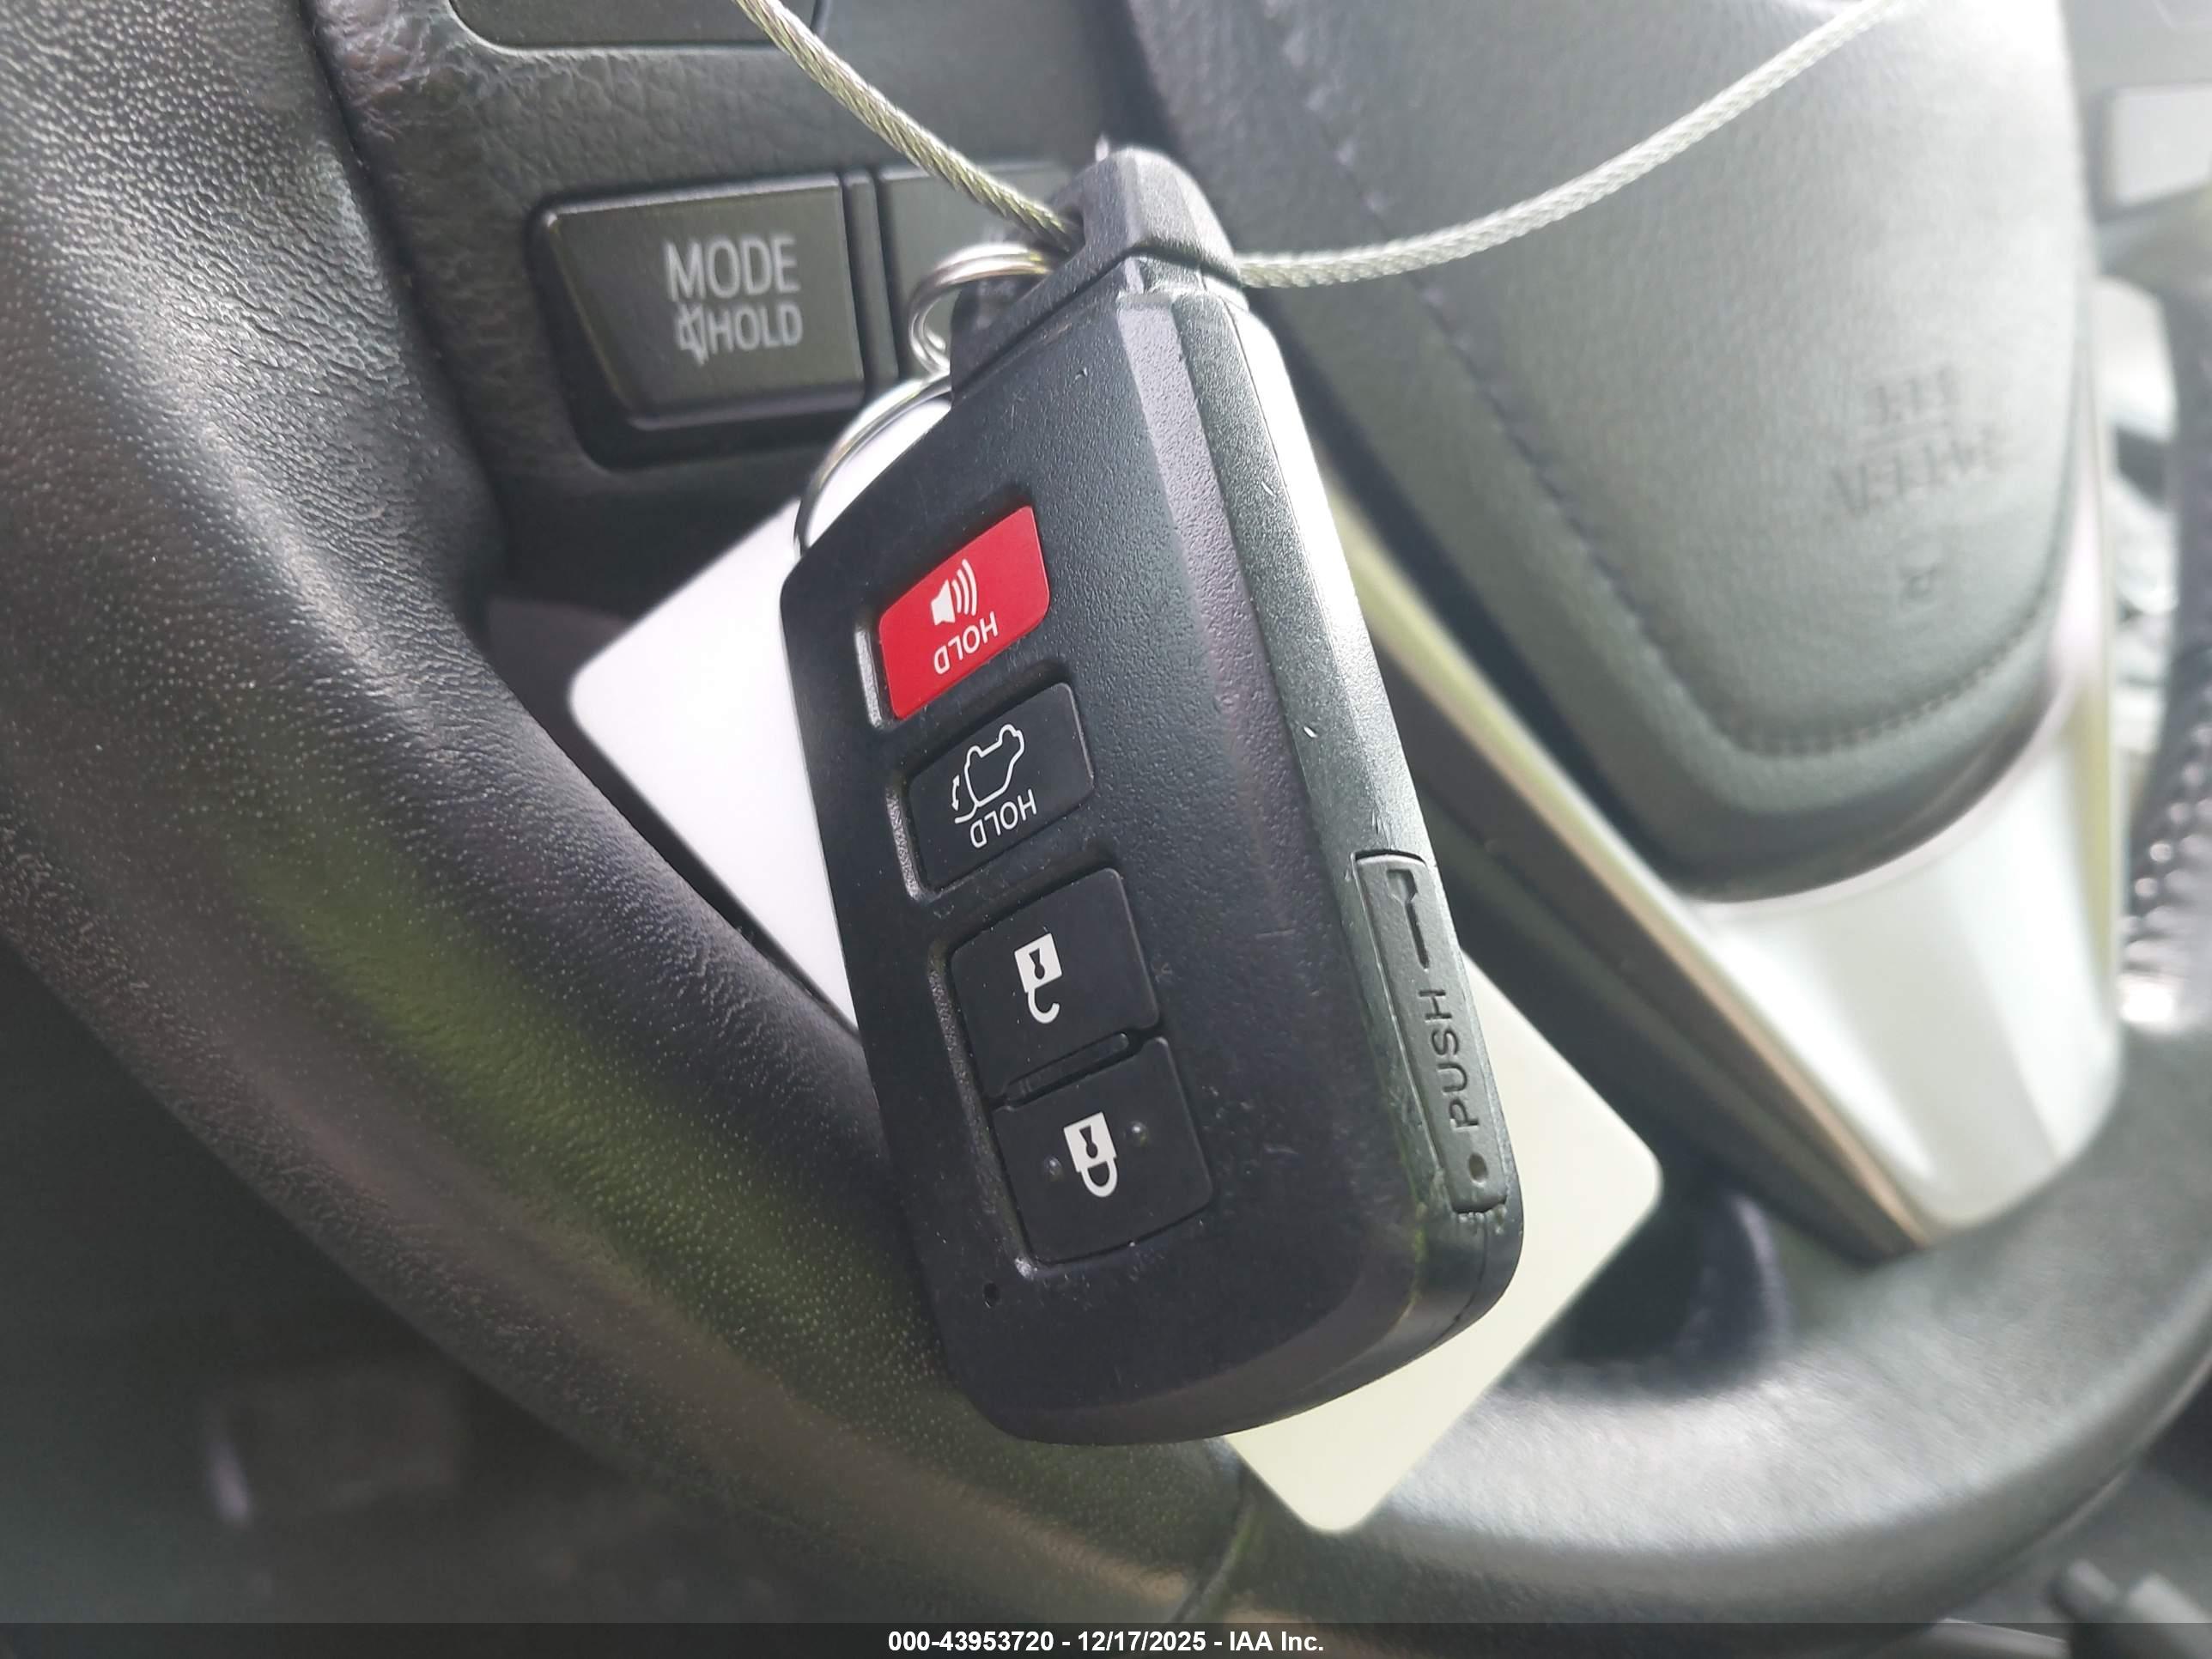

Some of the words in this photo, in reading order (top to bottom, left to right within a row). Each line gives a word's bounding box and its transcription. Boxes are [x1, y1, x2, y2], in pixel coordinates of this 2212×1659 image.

[664, 233, 800, 302] MODE
[709, 301, 804, 355] HOLD
[933, 611, 999, 675] HOLD
[969, 788, 1037, 848] HOLD
[1419, 988, 1479, 1131] PUSH
